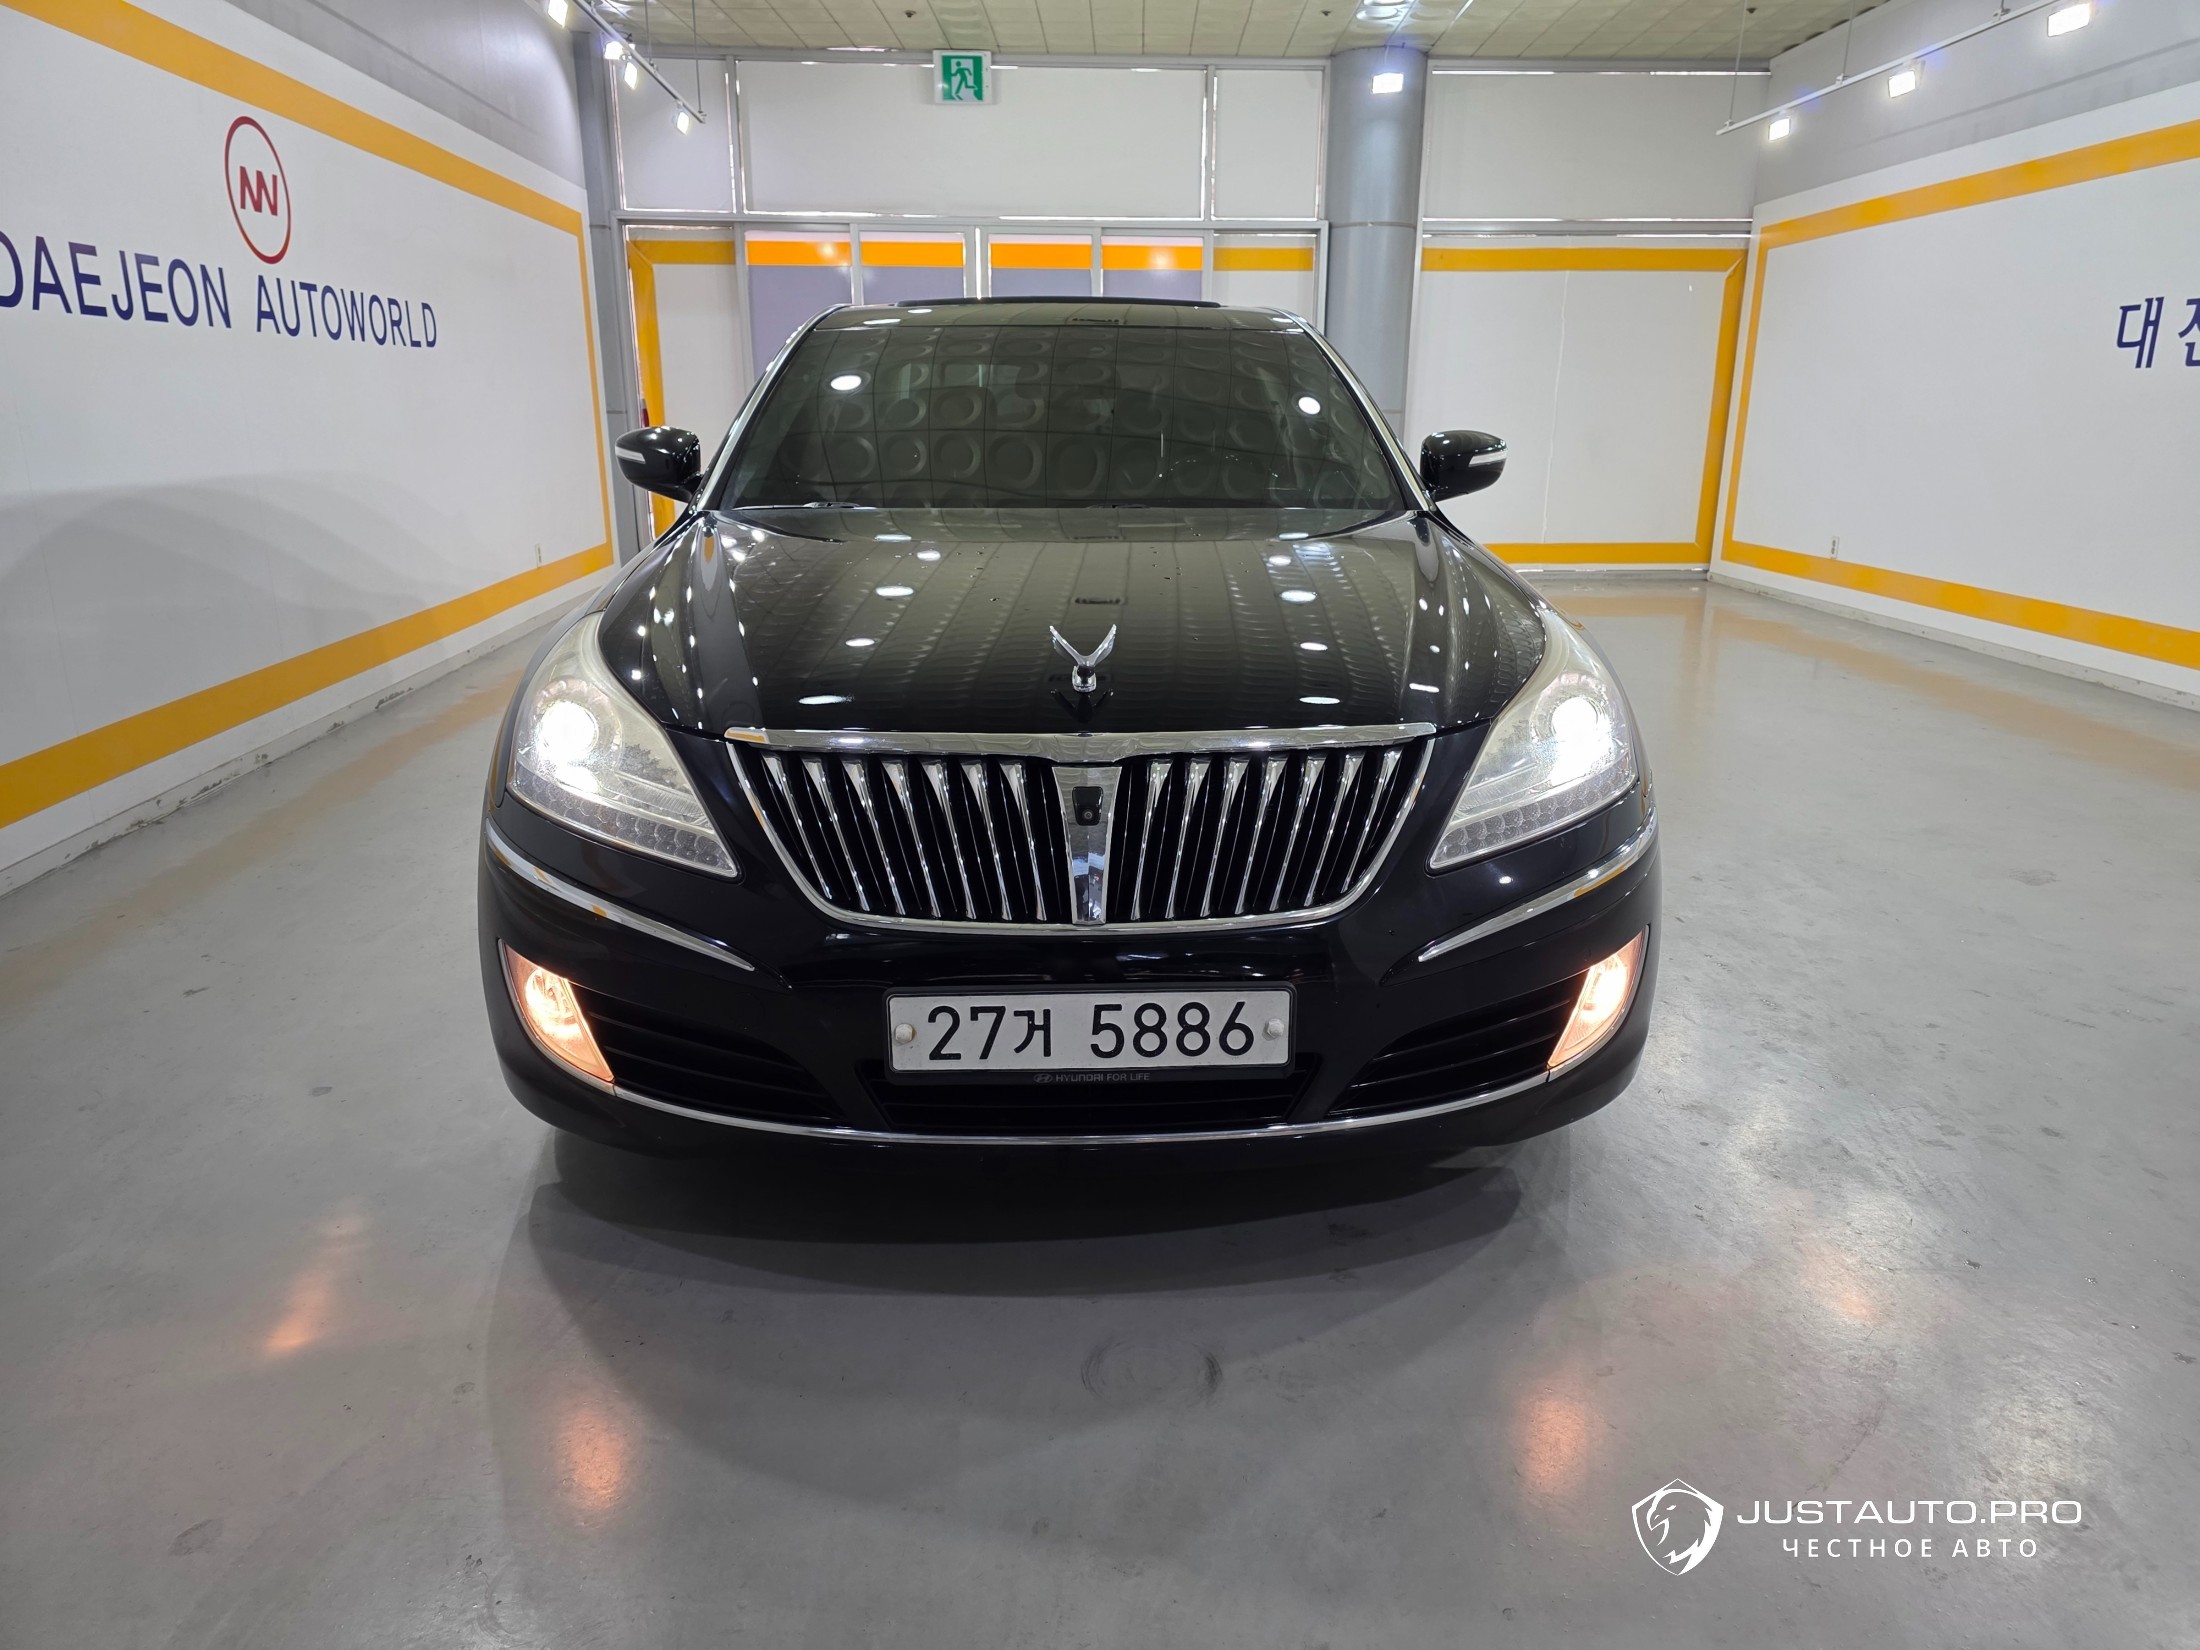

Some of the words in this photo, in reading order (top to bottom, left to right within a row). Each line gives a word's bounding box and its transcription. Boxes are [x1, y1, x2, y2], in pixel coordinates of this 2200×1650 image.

[256, 274, 437, 348] AUTOWORLD
[927, 1005, 1052, 1061] 27거
[1090, 1001, 1254, 1059] 5886
[1107, 1073, 1127, 1081] FOR
[1130, 1072, 1151, 1081] LIFE
